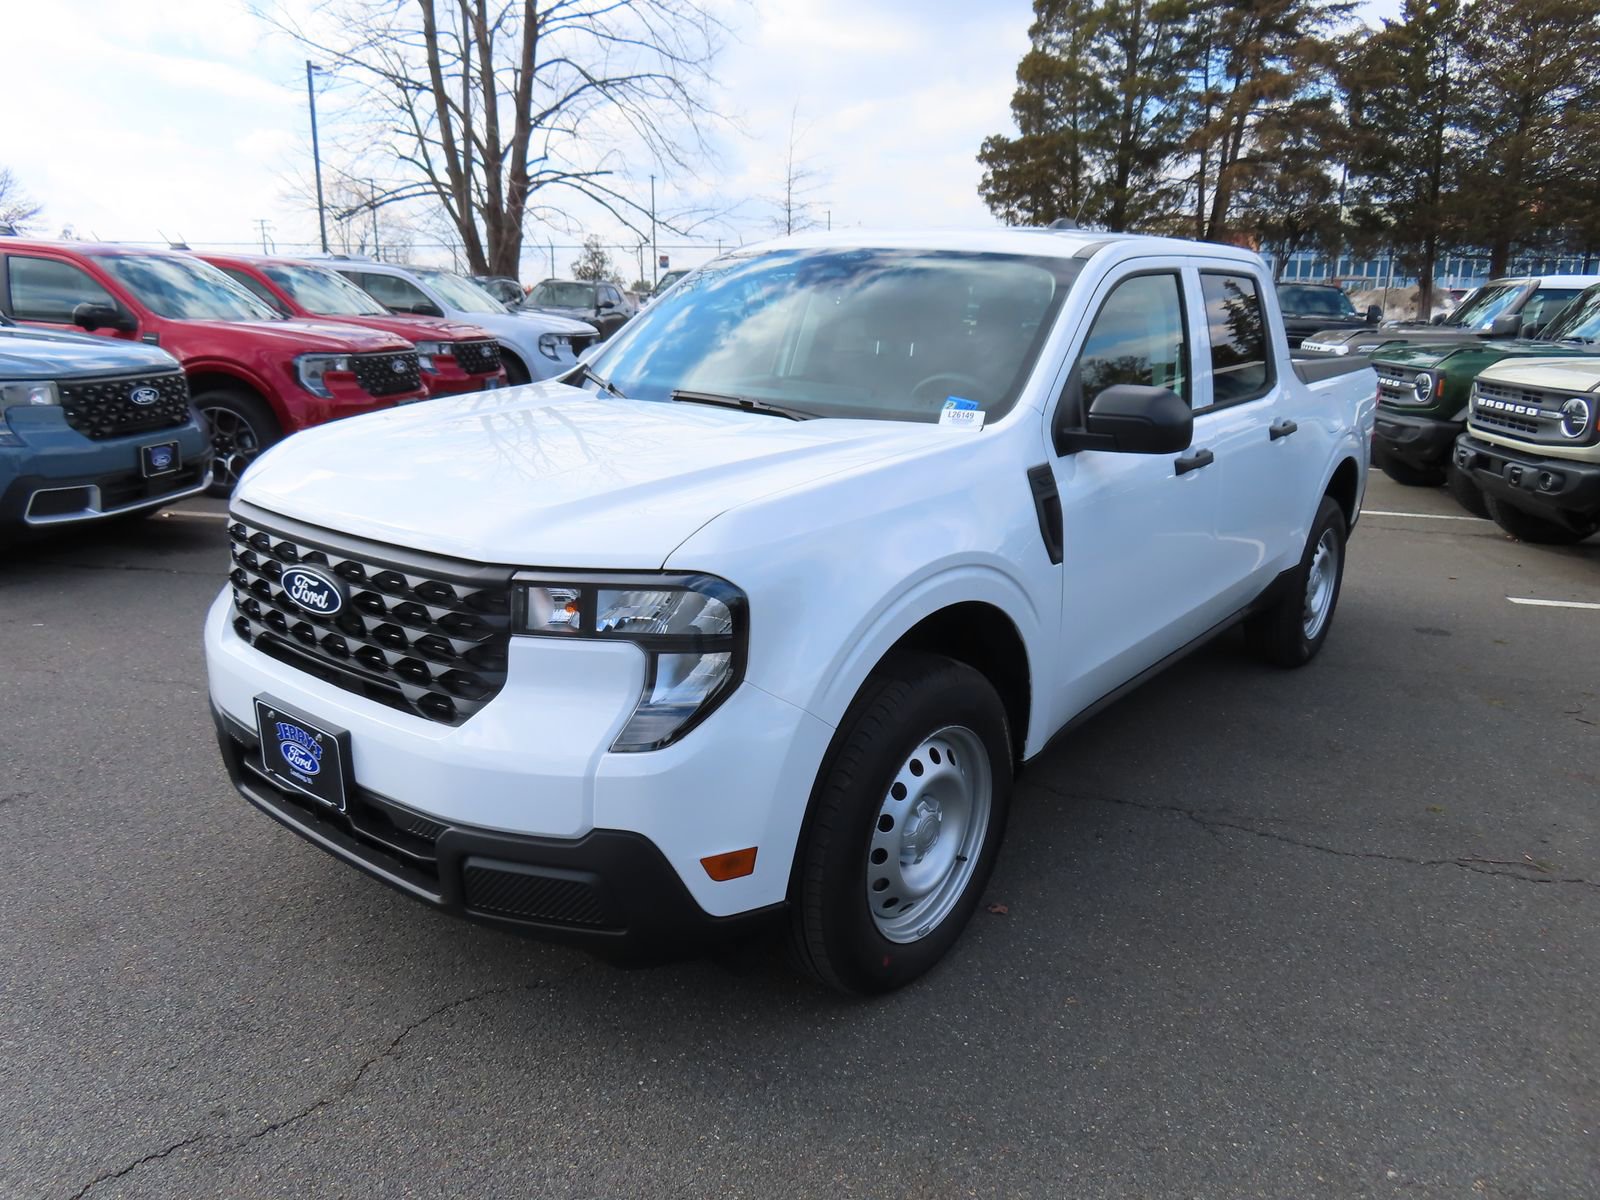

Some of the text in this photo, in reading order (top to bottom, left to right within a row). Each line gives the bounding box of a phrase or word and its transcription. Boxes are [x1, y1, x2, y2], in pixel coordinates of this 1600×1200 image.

[947, 410, 975, 420] L26149
[1477, 397, 1539, 416] BRONCO
[292, 574, 329, 609] Ford
[275, 721, 323, 761] JERRY'S
[287, 745, 313, 771] Ford
